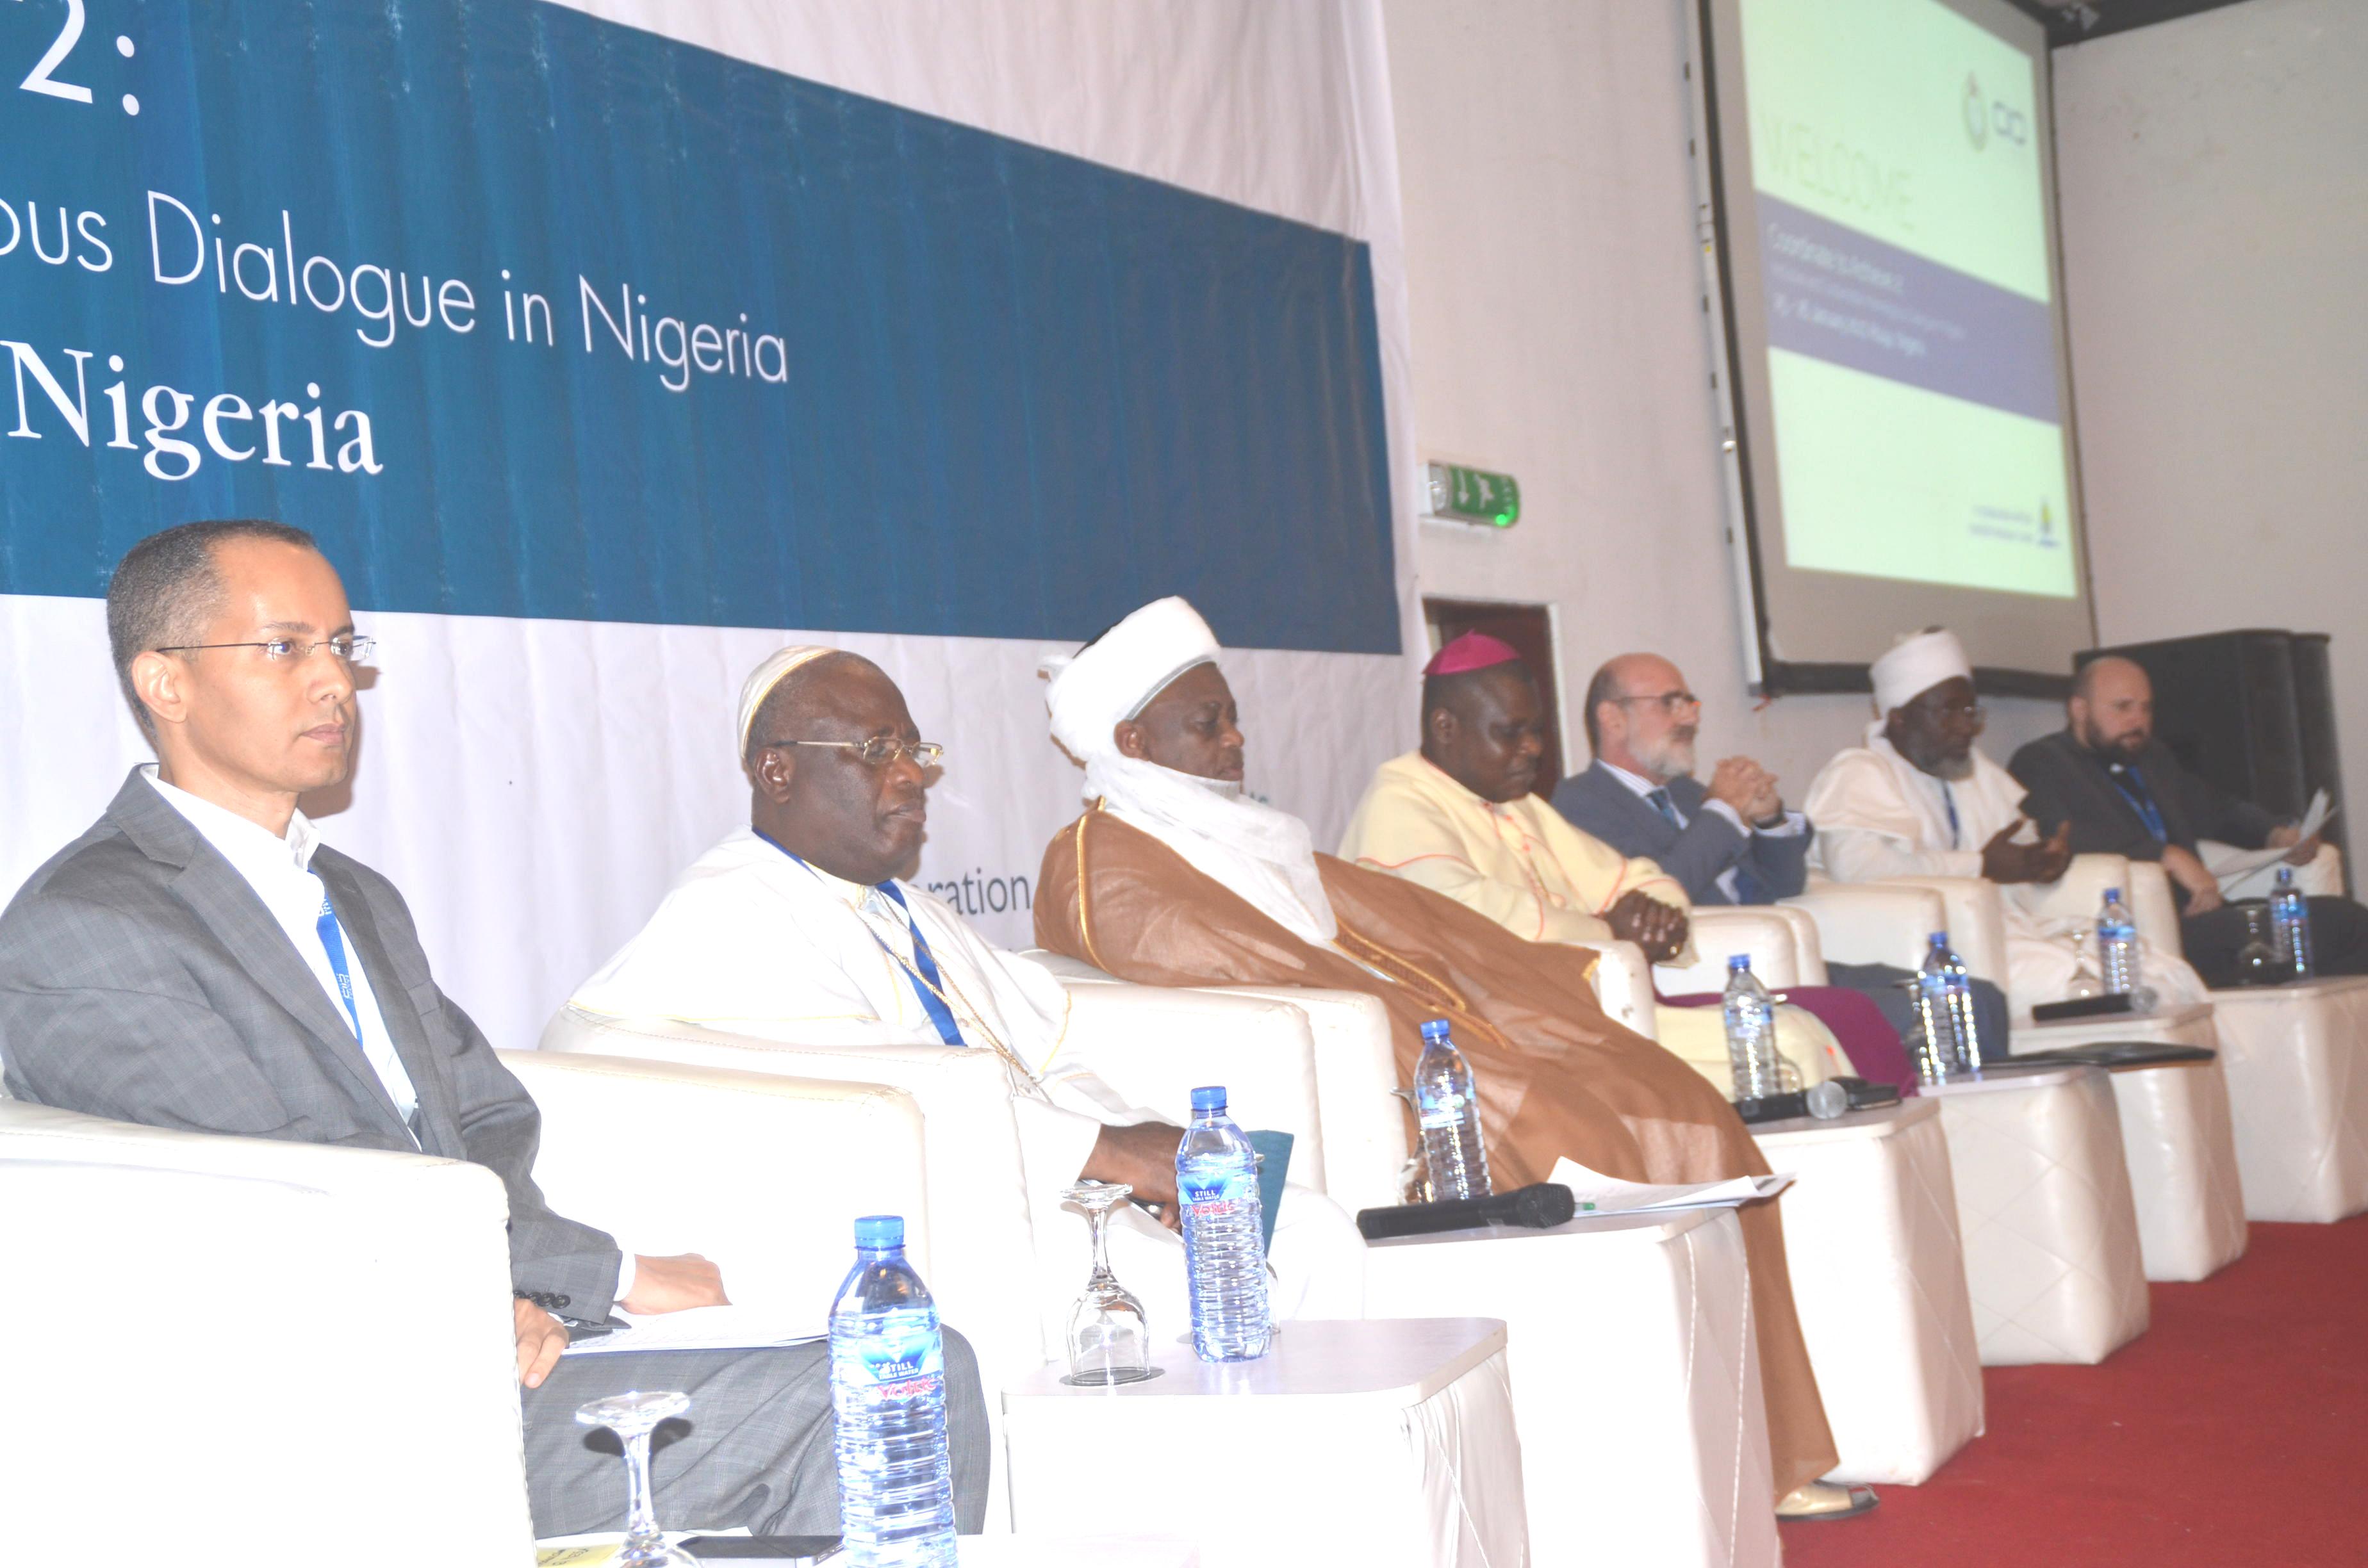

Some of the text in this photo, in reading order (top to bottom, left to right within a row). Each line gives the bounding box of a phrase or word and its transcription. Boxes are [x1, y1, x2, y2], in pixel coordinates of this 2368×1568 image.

[20, 0, 140, 116] 2:
[147, 190, 475, 347] Dialogue
[502, 270, 553, 345] in
[579, 275, 787, 391] Nigeria
[0, 340, 383, 480] Nigeria
[910, 867, 1030, 915] ration
